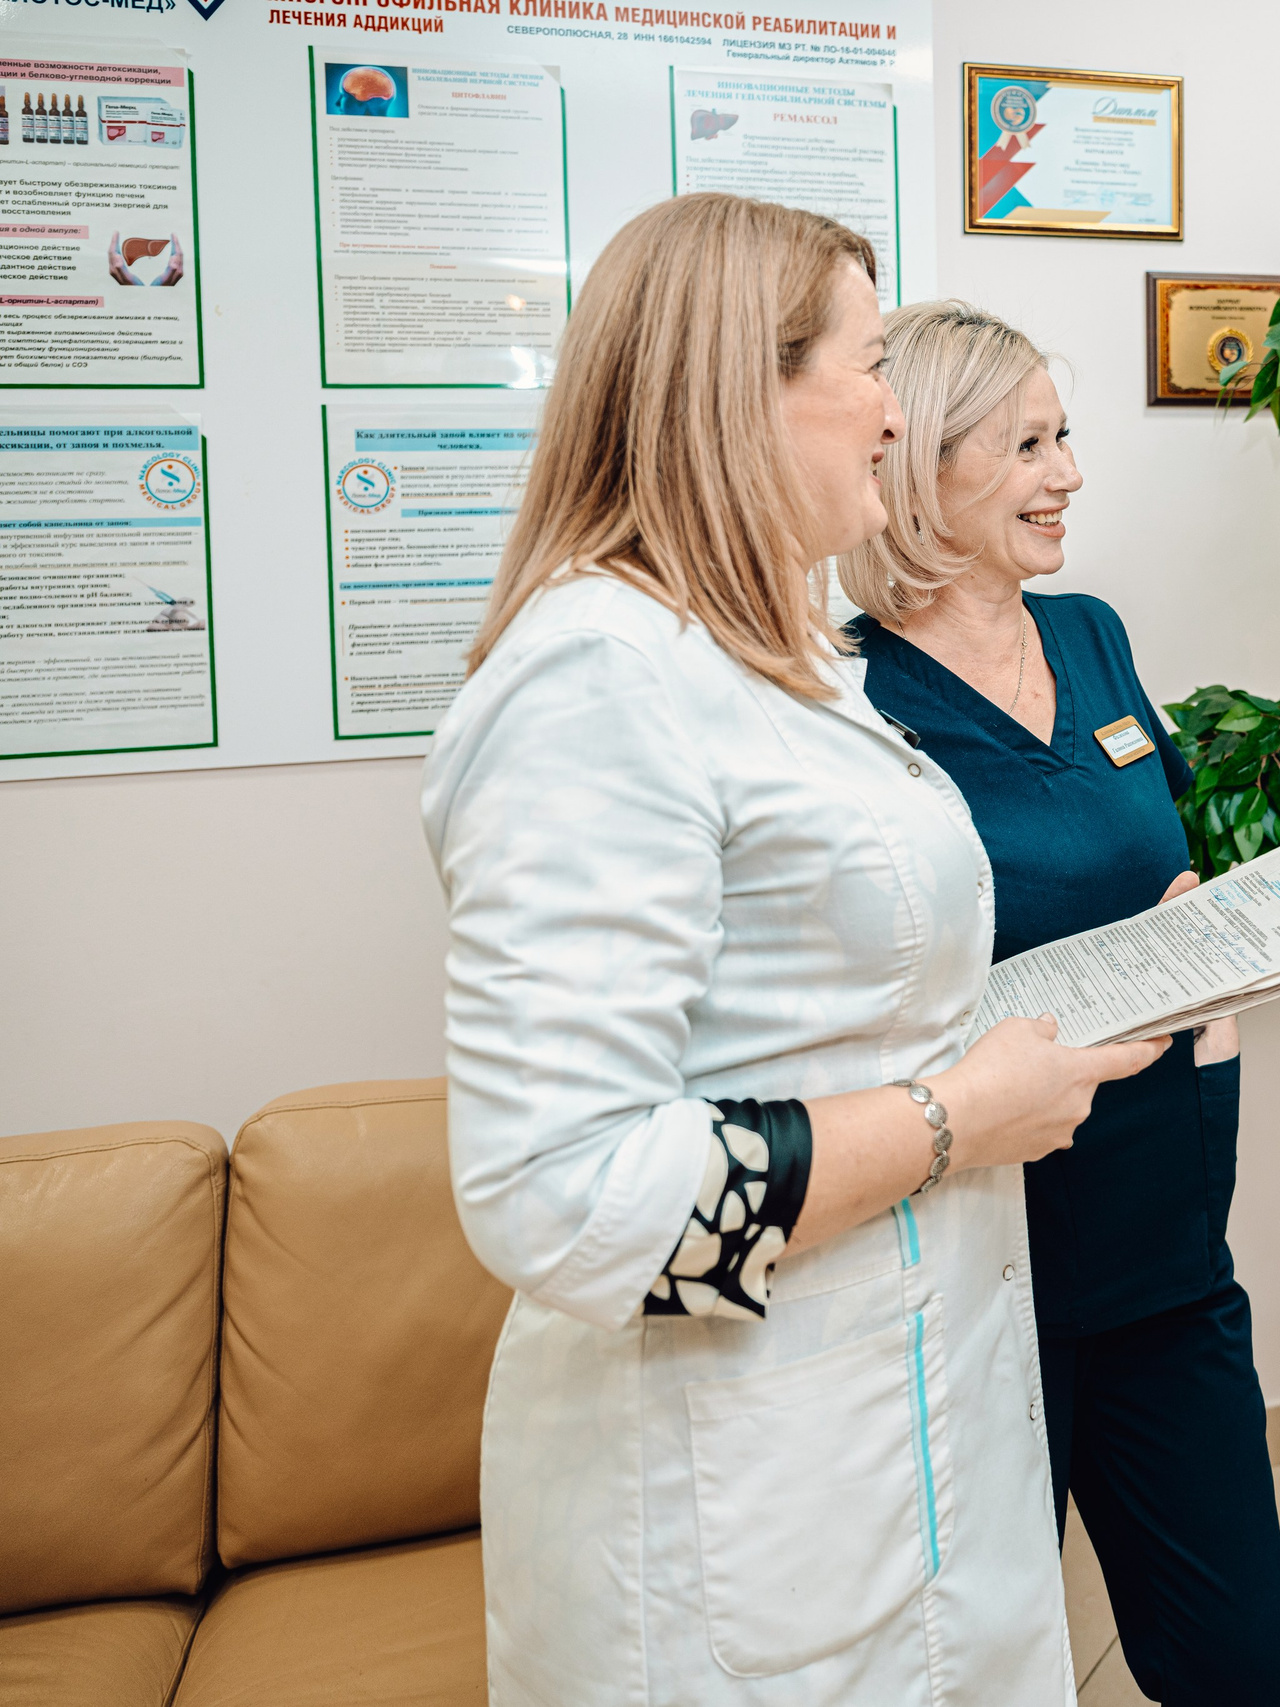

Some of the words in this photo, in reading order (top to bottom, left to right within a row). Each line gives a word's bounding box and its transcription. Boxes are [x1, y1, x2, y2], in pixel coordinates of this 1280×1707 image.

[268, 9, 347, 28] ЛЕЧЕНИЯ
[353, 14, 443, 34] АДДИКЦИЙ
[509, 0, 608, 21] КЛИНИКА
[614, 6, 746, 30] МЕДИЦИНСКОЙ
[752, 16, 881, 40] РЕАБИЛИТАЦИИ
[886, 25, 896, 40] И
[506, 25, 614, 40] СЕВЕРОПОЛЮСНАЯ,
[617, 32, 629, 41] 28
[634, 33, 655, 42] ИНН
[722, 38, 776, 50] ЛИЦЕНЗИЯ
[778, 42, 792, 52] МЗ
[727, 49, 791, 63] Генеральный
[792, 55, 836, 65] директор
[838, 56, 878, 67] Ахтямов
[34, 62, 94, 71] возможности
[96, 66, 162, 75] детоксикации,
[28, 71, 122, 82] белково-углеводной
[717, 81, 810, 95] ИННОВАЦИОННЫЕ
[812, 86, 856, 96] МЕТОДЫ
[684, 89, 733, 99] ЛЕЧЕНИЯ
[837, 98, 887, 109] СИСТЕМЫ
[773, 112, 838, 125] РЕМАКСОЛ
[19, 179, 62, 188] быстрому
[64, 180, 137, 189] обезвреживанию
[13, 189, 72, 197] возобновляет
[74, 190, 113, 198] функцию
[11, 199, 69, 207] ослабленный
[48, 227, 81, 235] ампуле:
[103, 430, 123, 438] при
[126, 428, 193, 436] алкогольной
[356, 431, 375, 439] Как
[377, 430, 437, 439] длительный
